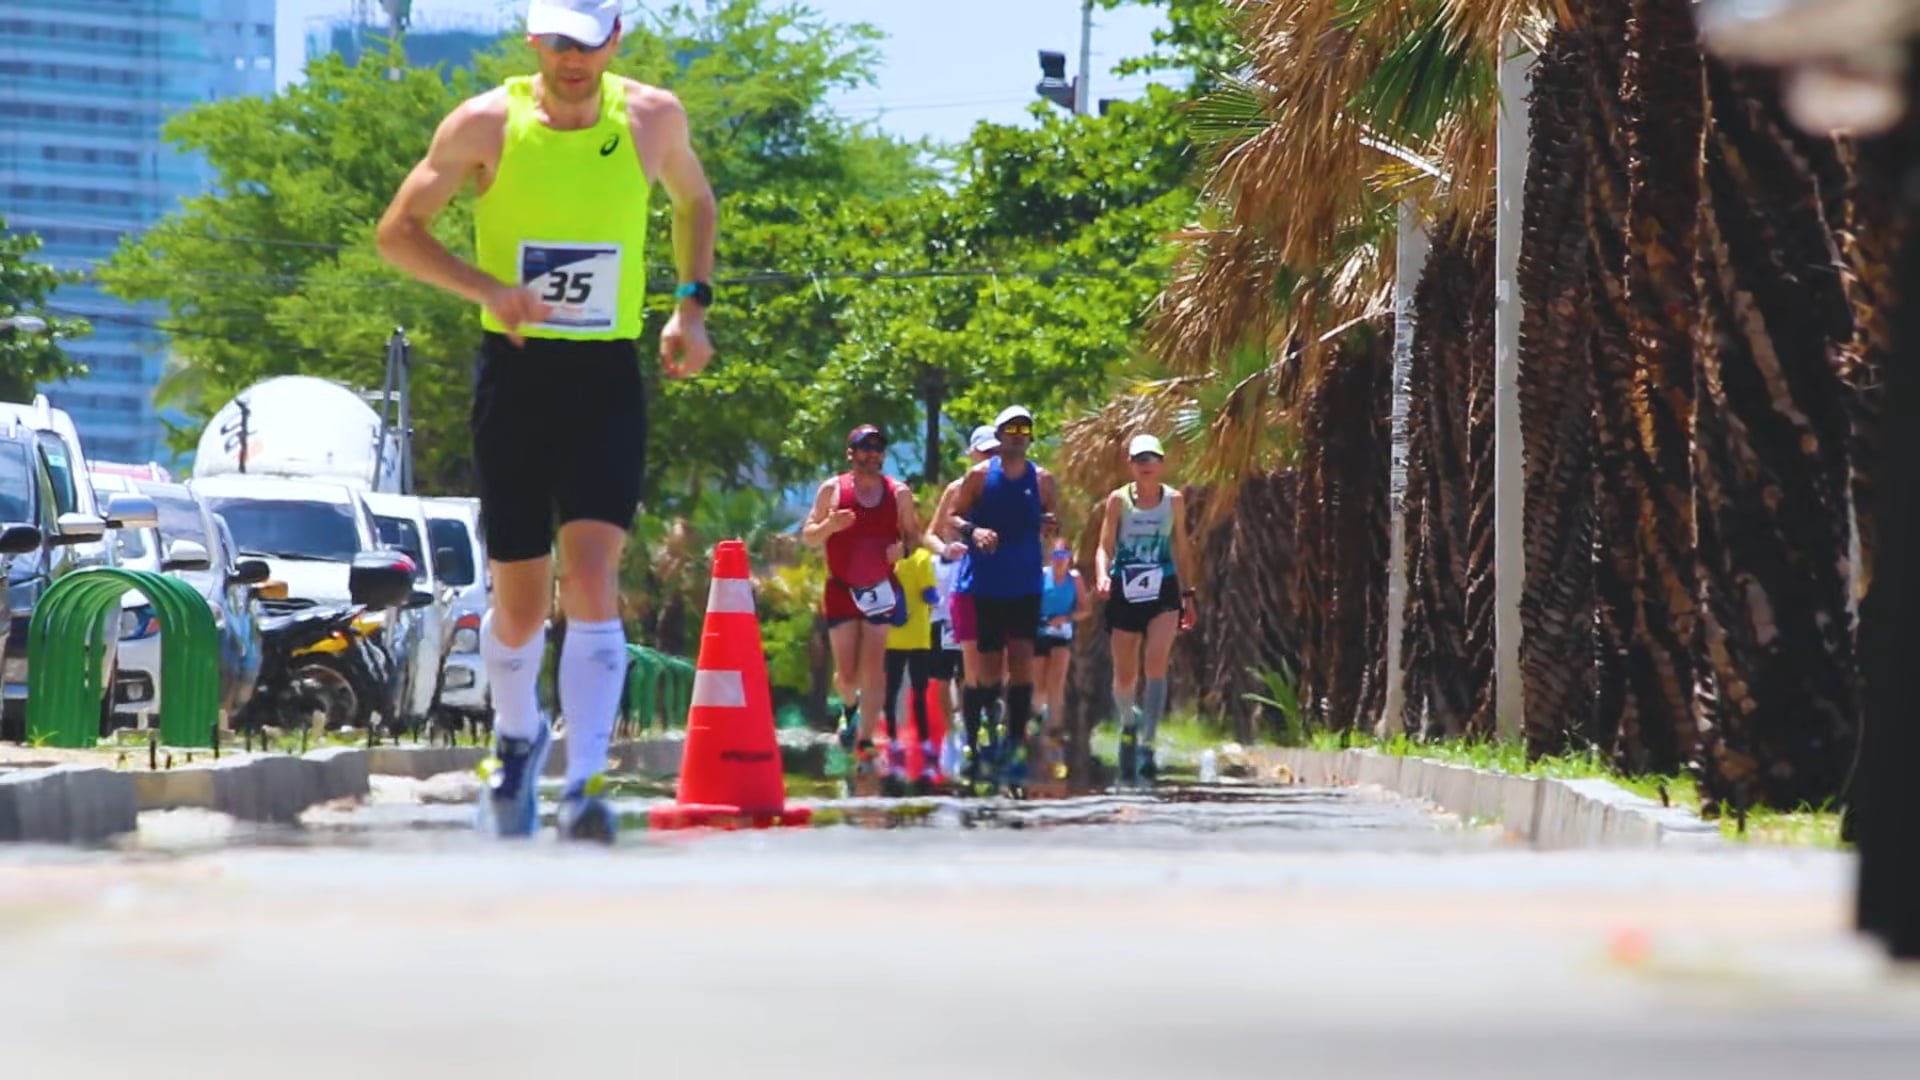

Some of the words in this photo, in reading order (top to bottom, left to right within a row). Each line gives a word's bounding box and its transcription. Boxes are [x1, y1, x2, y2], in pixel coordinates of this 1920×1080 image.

[542, 271, 594, 303] 35
[1138, 576, 1149, 589] 4
[868, 589, 877, 604] 3
